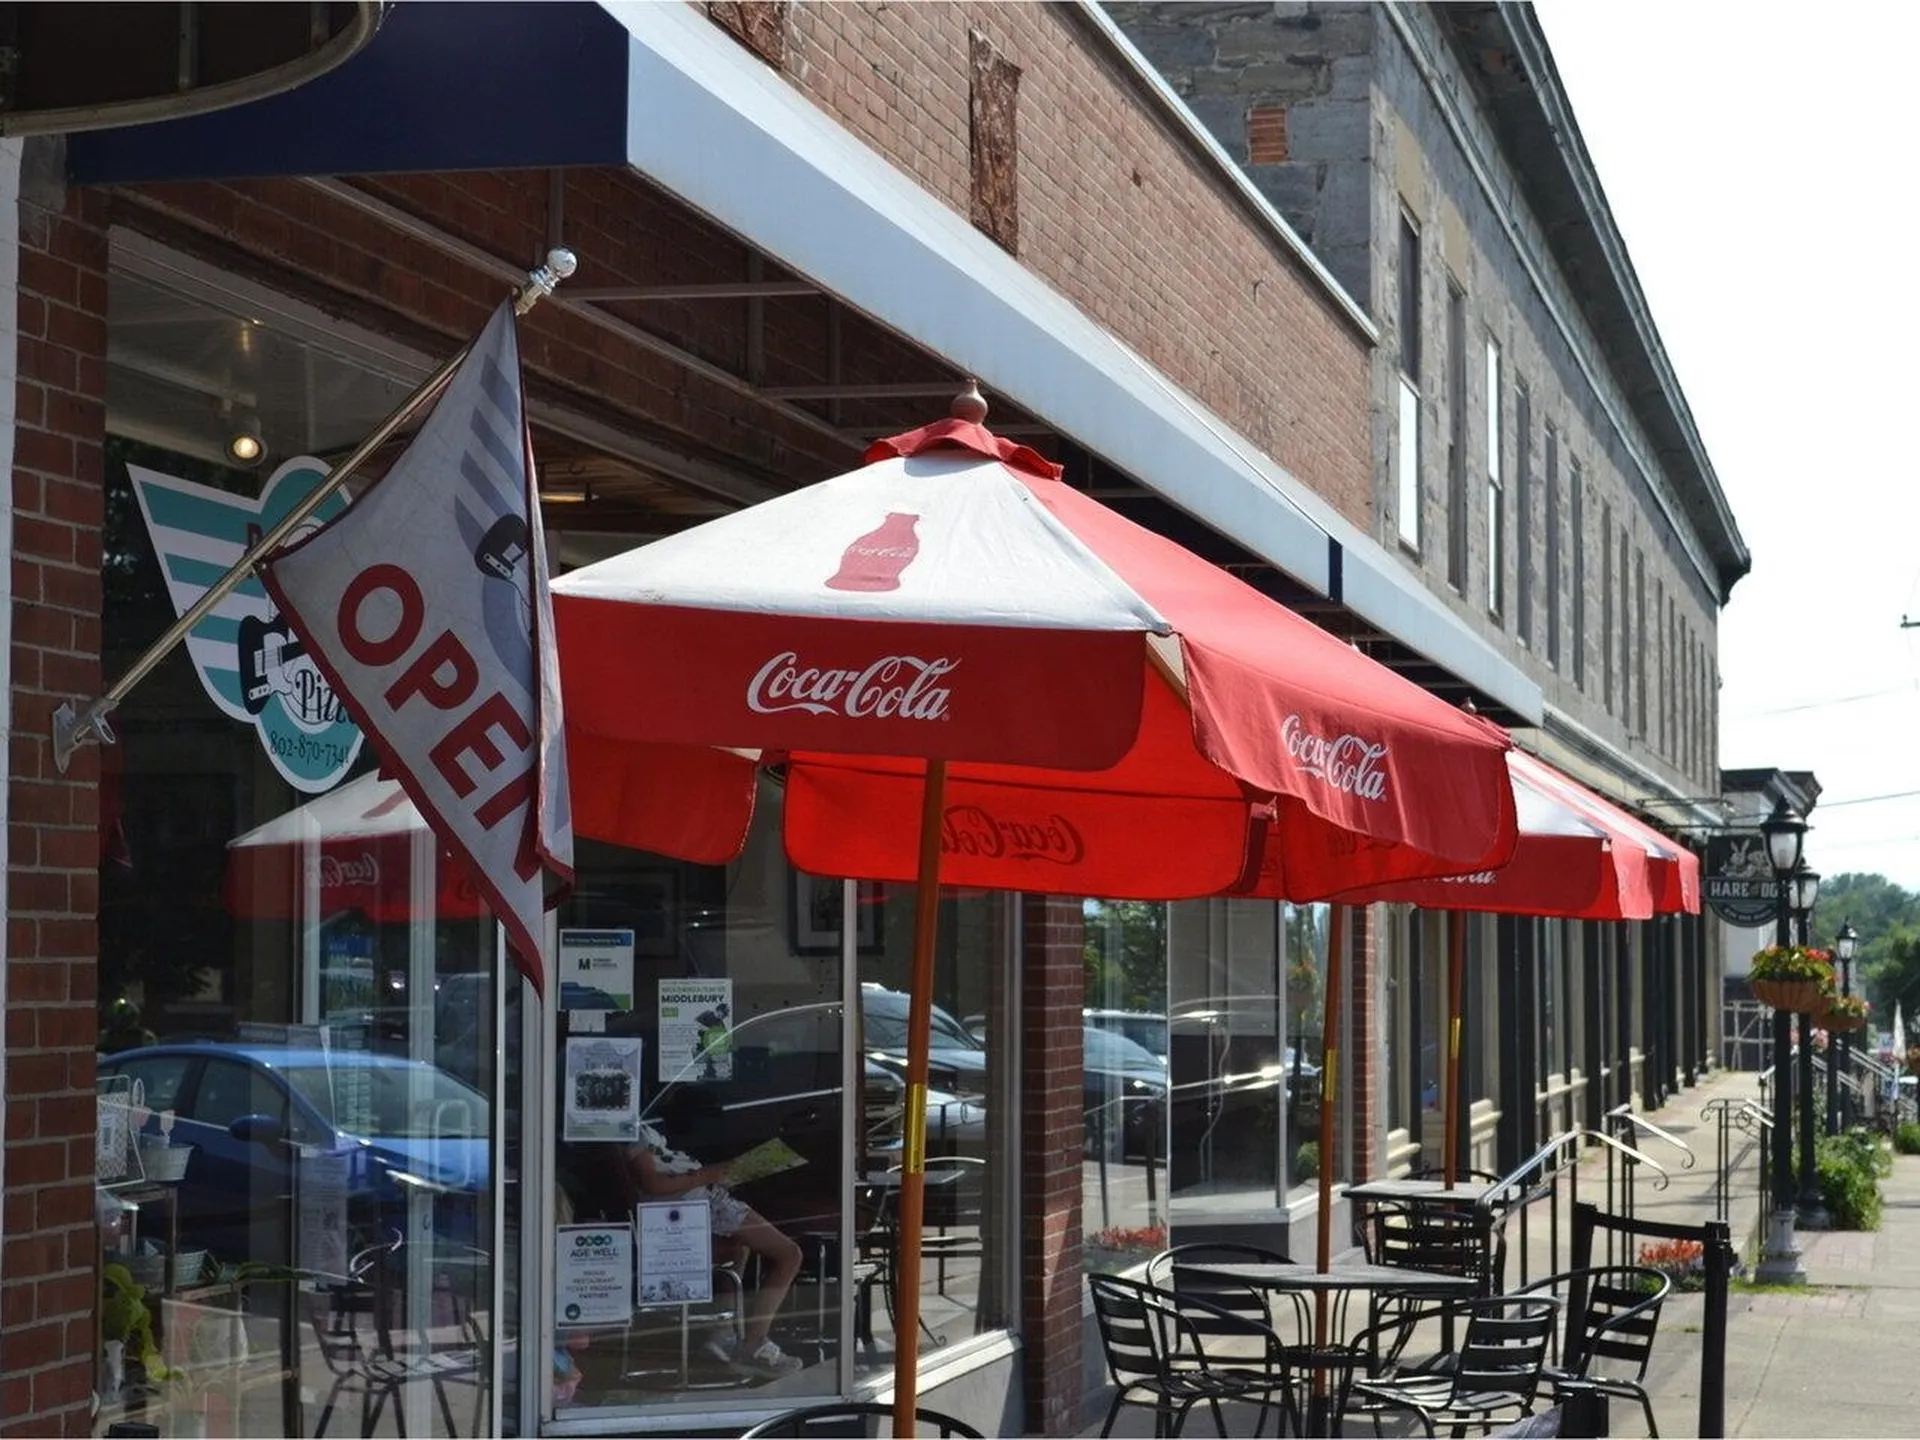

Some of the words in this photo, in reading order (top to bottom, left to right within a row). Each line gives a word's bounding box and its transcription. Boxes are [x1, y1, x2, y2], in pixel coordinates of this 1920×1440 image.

[747, 652, 962, 721] Coca-Cola
[1281, 714, 1390, 801] Coca-Cola
[1710, 881, 1750, 898] HARE
[661, 994, 725, 1003] MIDDLEBURY
[570, 1248, 589, 1258] AGE
[593, 1247, 620, 1258] WELL
